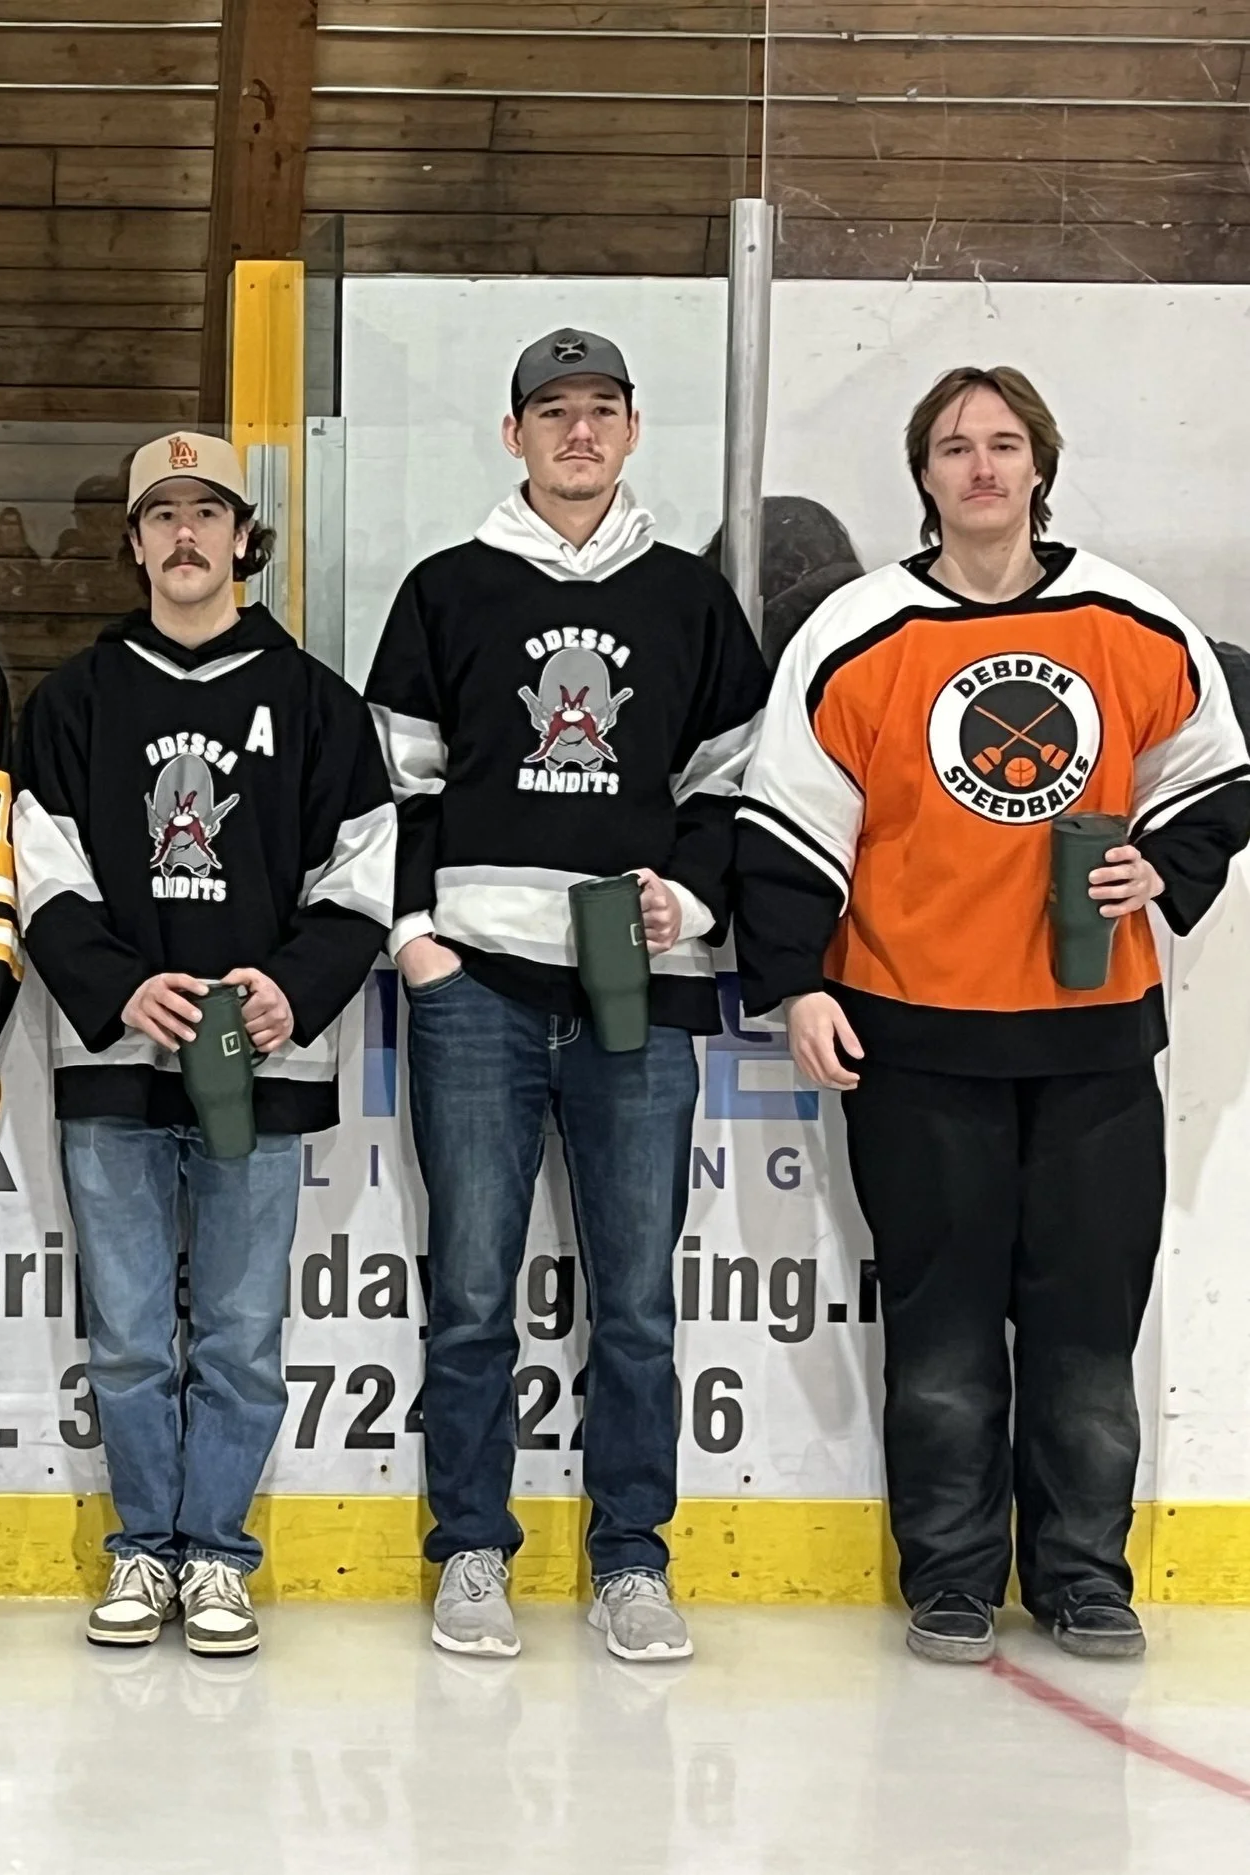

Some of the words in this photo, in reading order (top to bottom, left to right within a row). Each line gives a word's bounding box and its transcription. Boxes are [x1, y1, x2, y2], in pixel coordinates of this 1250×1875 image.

[168, 436, 198, 470] LA
[525, 626, 631, 668] ODESSA
[953, 659, 1074, 699] DEBDEN
[245, 705, 274, 757] A
[145, 731, 239, 775] ODESSA
[517, 767, 620, 795] BANDITS
[943, 754, 1090, 819] SPEEDBALLS
[151, 875, 227, 902] ANDITS
